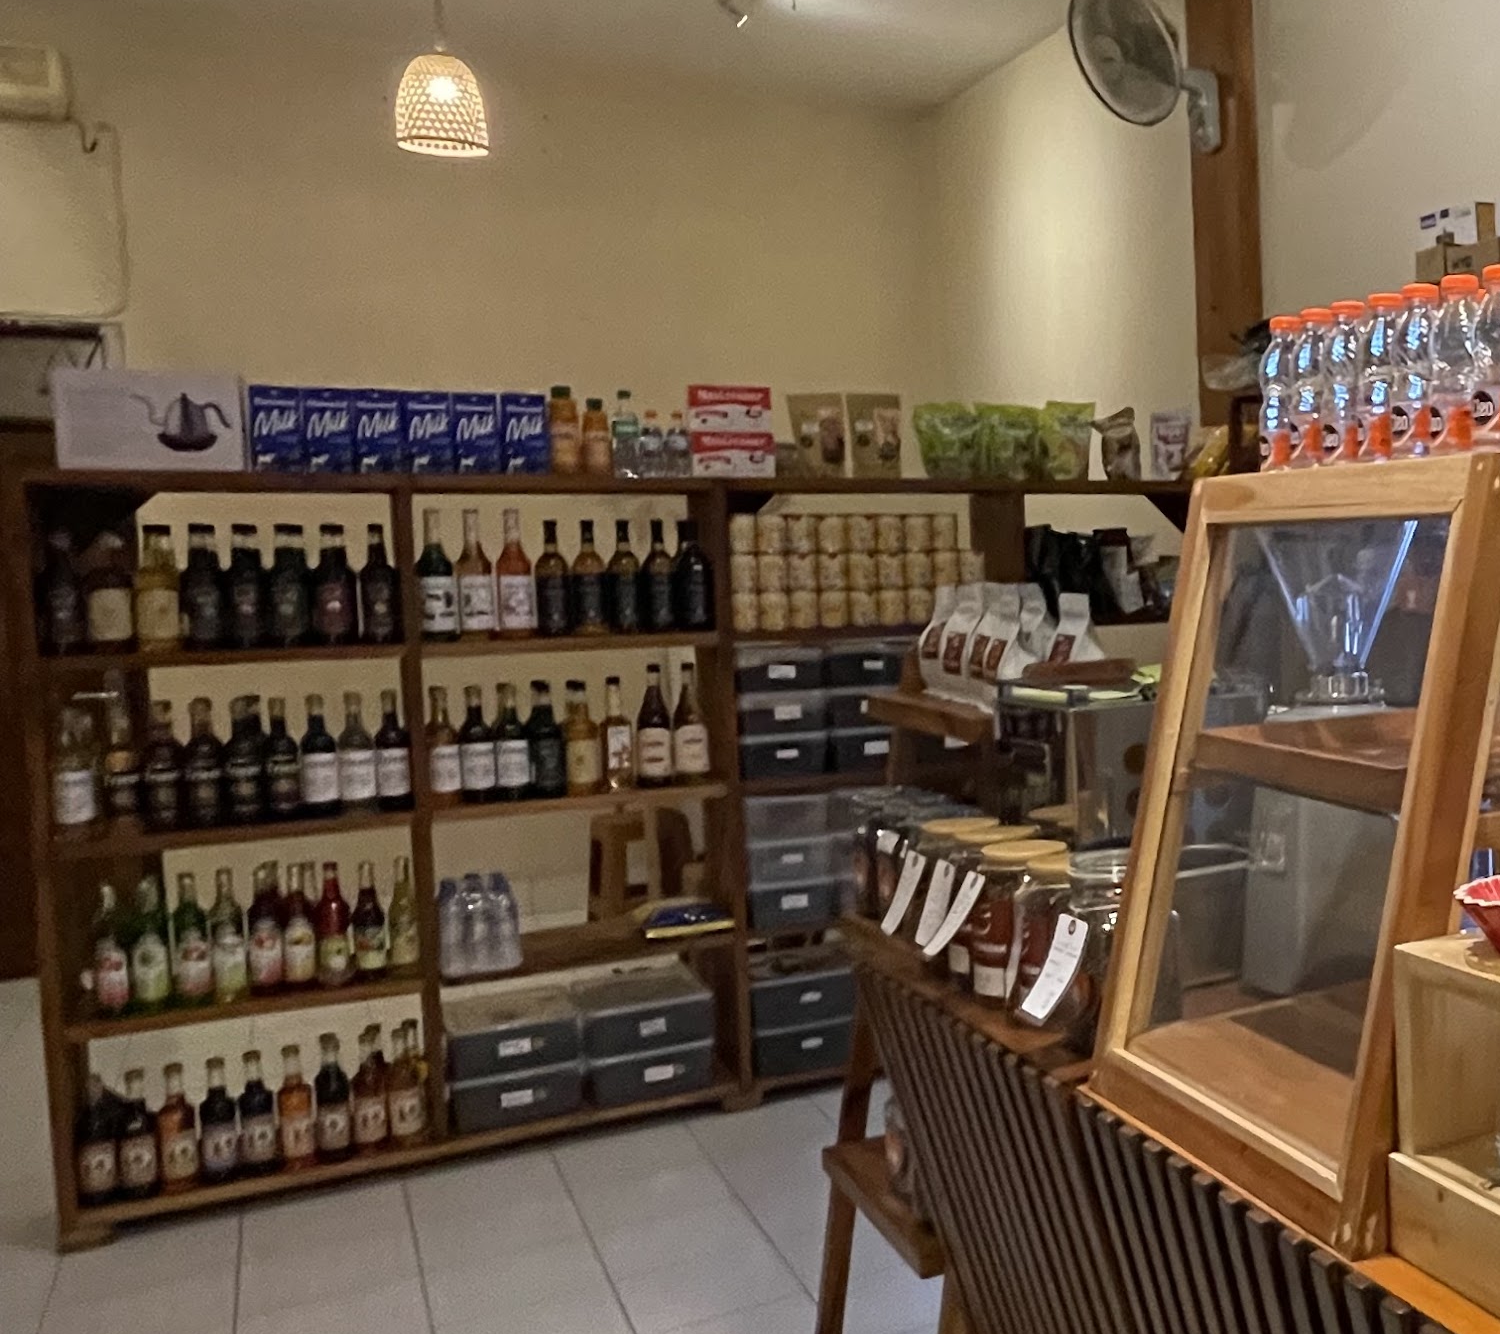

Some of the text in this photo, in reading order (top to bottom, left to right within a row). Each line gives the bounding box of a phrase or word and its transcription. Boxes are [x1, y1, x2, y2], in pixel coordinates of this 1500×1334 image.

[253, 408, 298, 437] Milk
[306, 410, 349, 440] Milk
[357, 410, 400, 439] Milk
[409, 412, 449, 442] Milk
[456, 413, 495, 442] Milk
[505, 414, 543, 443] Milk
